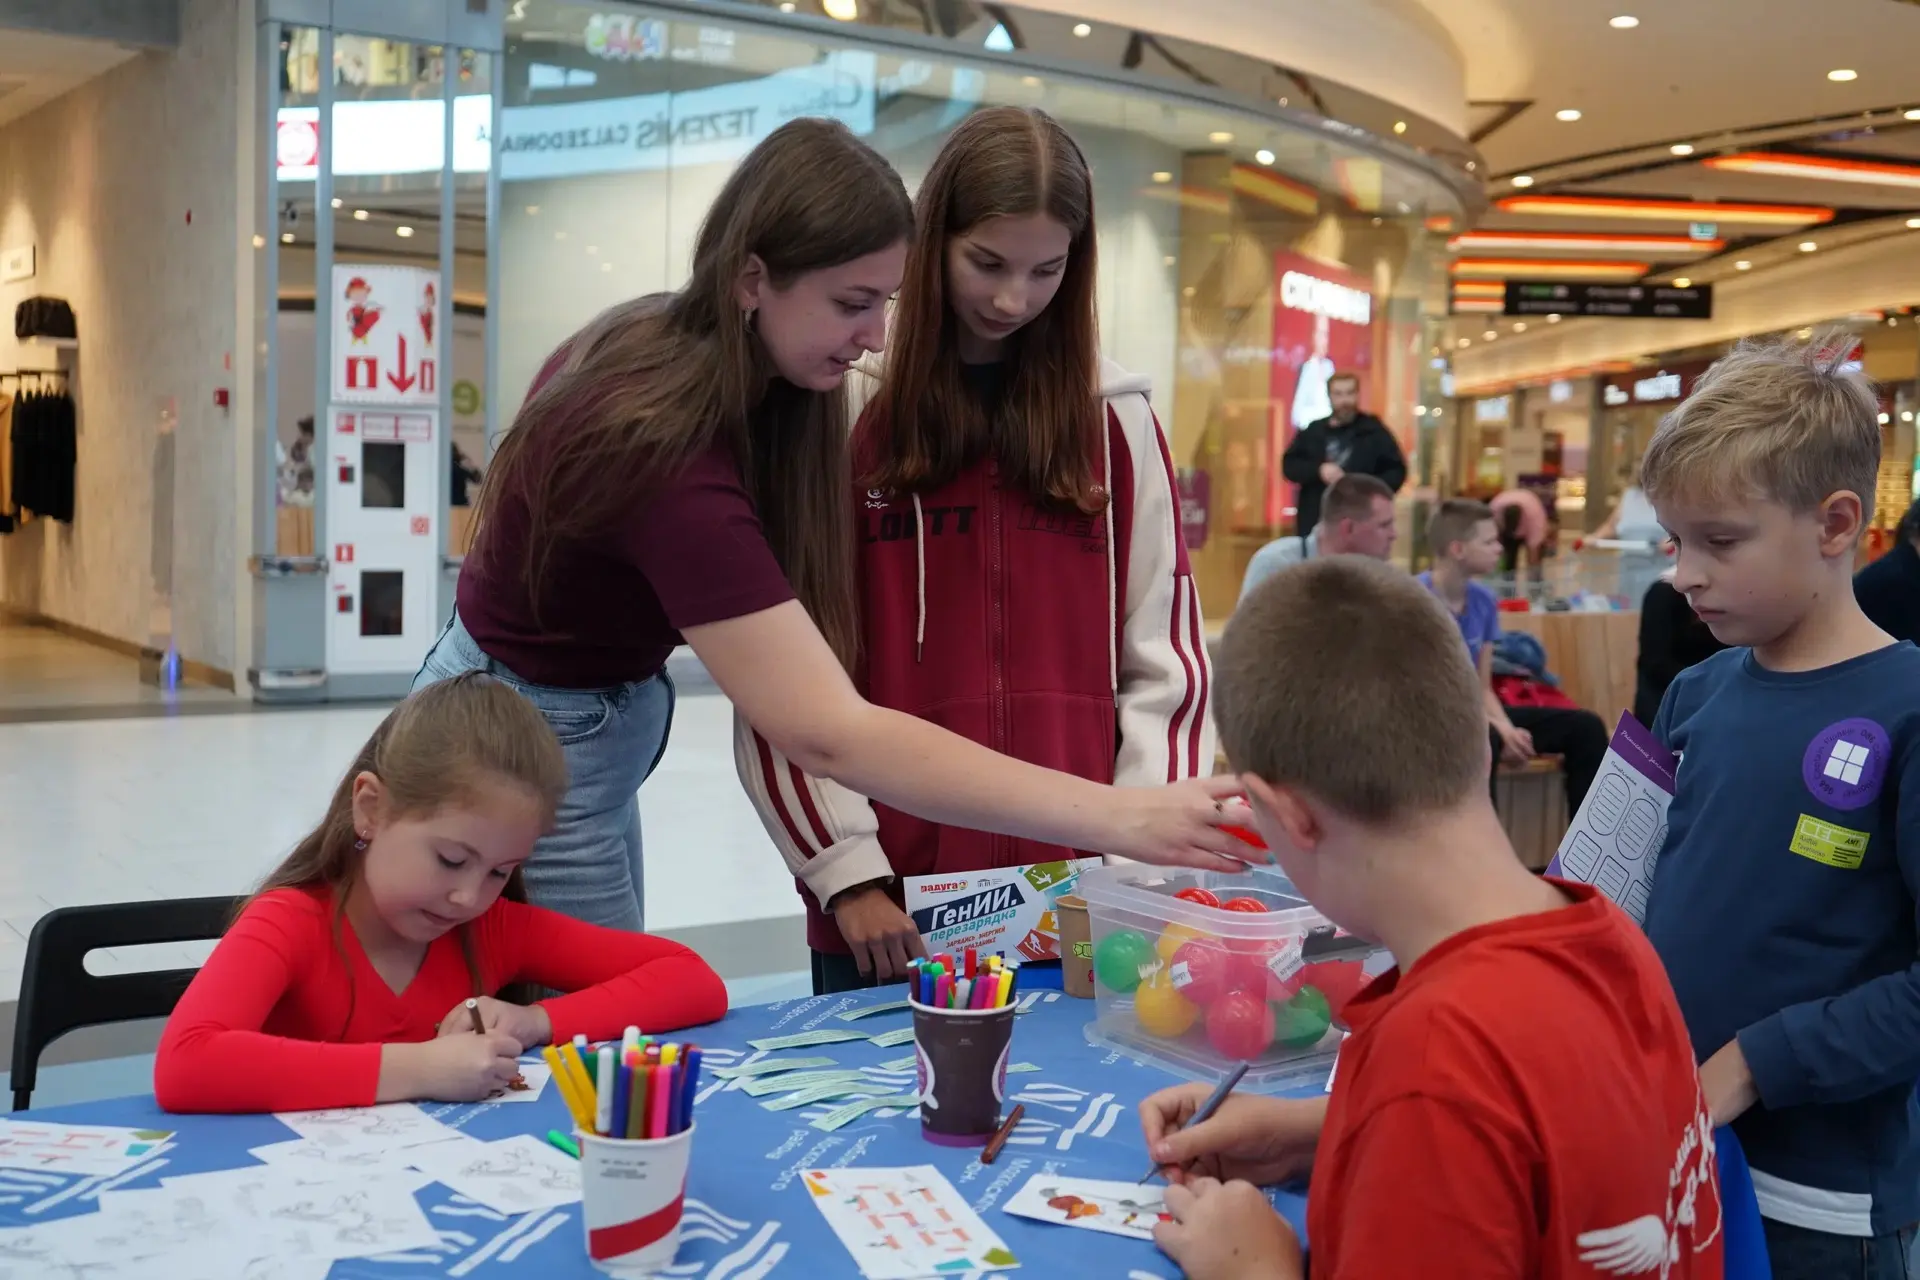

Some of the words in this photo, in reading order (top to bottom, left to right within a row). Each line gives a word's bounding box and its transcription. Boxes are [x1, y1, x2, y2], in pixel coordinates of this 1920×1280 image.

[920, 882, 958, 893] радуга
[930, 885, 1018, 931] ГенИИ.
[930, 908, 1016, 943] перезарядка
